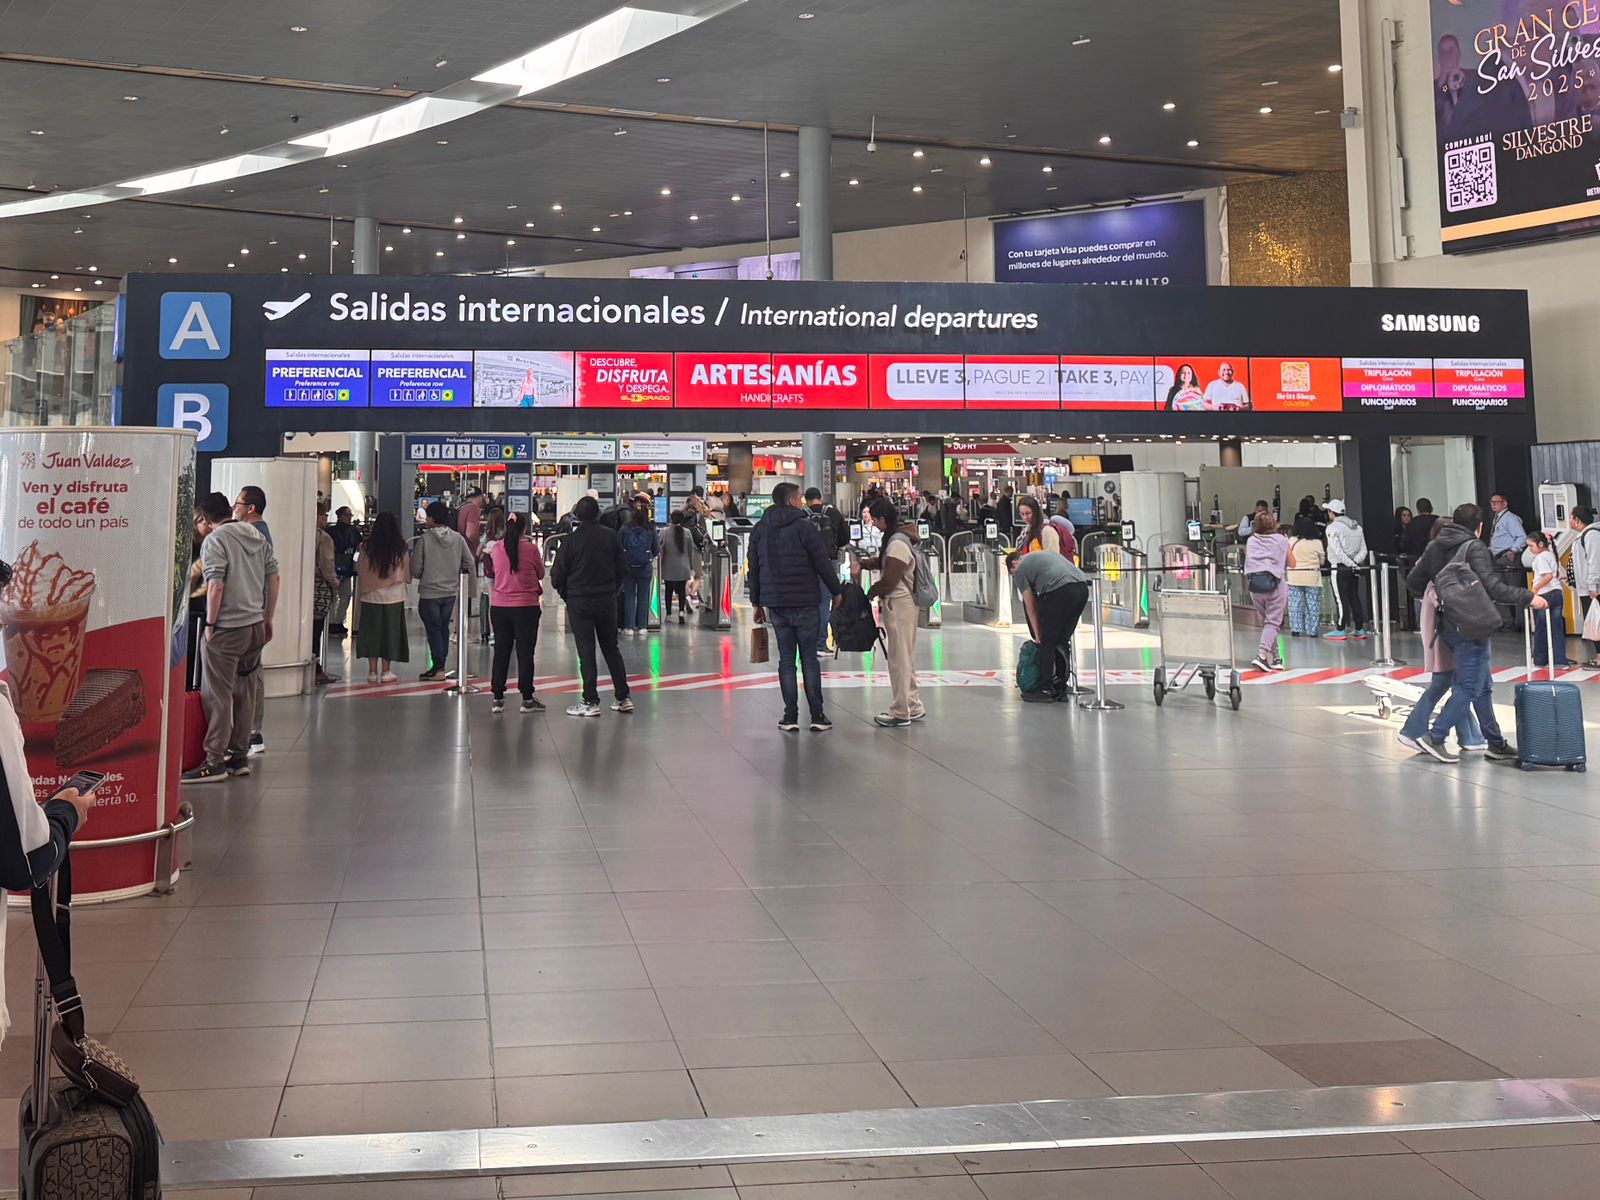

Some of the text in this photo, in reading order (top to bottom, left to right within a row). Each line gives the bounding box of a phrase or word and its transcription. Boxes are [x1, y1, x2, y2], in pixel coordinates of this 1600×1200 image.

[1474, 9, 1553, 55] GRAN
[1511, 46, 1526, 59] DE
[1477, 48, 1526, 94] San
[1528, 69, 1584, 101] 2025
[1503, 114, 1593, 151] SILVESTRE
[1445, 138, 1472, 150] COMPRA
[1516, 134, 1583, 160] DANGOND
[1008, 250, 1023, 259] Con
[1034, 247, 1060, 258] tarjeta
[1061, 245, 1077, 255] Visa
[1078, 243, 1108, 255] puedes
[1109, 241, 1144, 252] comprar
[1145, 239, 1156, 247] en
[1008, 250, 1169, 271] millones de lugares alrededor del mundo.
[329, 292, 1039, 335] Salidas internacionales / International departures
[169, 301, 220, 350] A
[1381, 314, 1480, 332] SAMSUNG
[589, 357, 638, 368] DESCUBRE,
[272, 367, 364, 379] PREFERENCIAL
[377, 367, 466, 379] PREFERENCIAL
[596, 369, 669, 384] DISFRUTA
[690, 360, 857, 386] ARTESANÍAS
[896, 368, 949, 385] LLEVE
[953, 368, 971, 387] 3,
[974, 369, 1031, 385] PAGUE
[1035, 369, 1046, 385] 2
[1055, 369, 1099, 385] TAKE
[1103, 370, 1118, 387] 3,
[1120, 370, 1148, 386] PAY
[1155, 370, 1165, 385] 2
[1364, 368, 1412, 377] TRIPULACIÓN
[1455, 369, 1503, 377] TRIPULACIÓN
[294, 379, 326, 388] Preference
[399, 380, 431, 388] Preference
[618, 384, 670, 394] Y DESPEGA.
[1361, 382, 1416, 391] DIPLOMÁTICOS
[1452, 383, 1507, 392] DIPLOMÁTICOS
[740, 393, 804, 404] HANDICRAFTS
[1361, 398, 1417, 406] FUNCIONARIOS
[1452, 398, 1508, 406] FUNCIONARIOS
[173, 392, 212, 442] B
[42, 452, 133, 470] Juan Valdez
[22, 480, 129, 496] Ven y disfruta
[36, 497, 110, 515] el café
[18, 515, 129, 531] de todo un país
[114, 784, 122, 796] y
[94, 792, 138, 807] erta 10.
